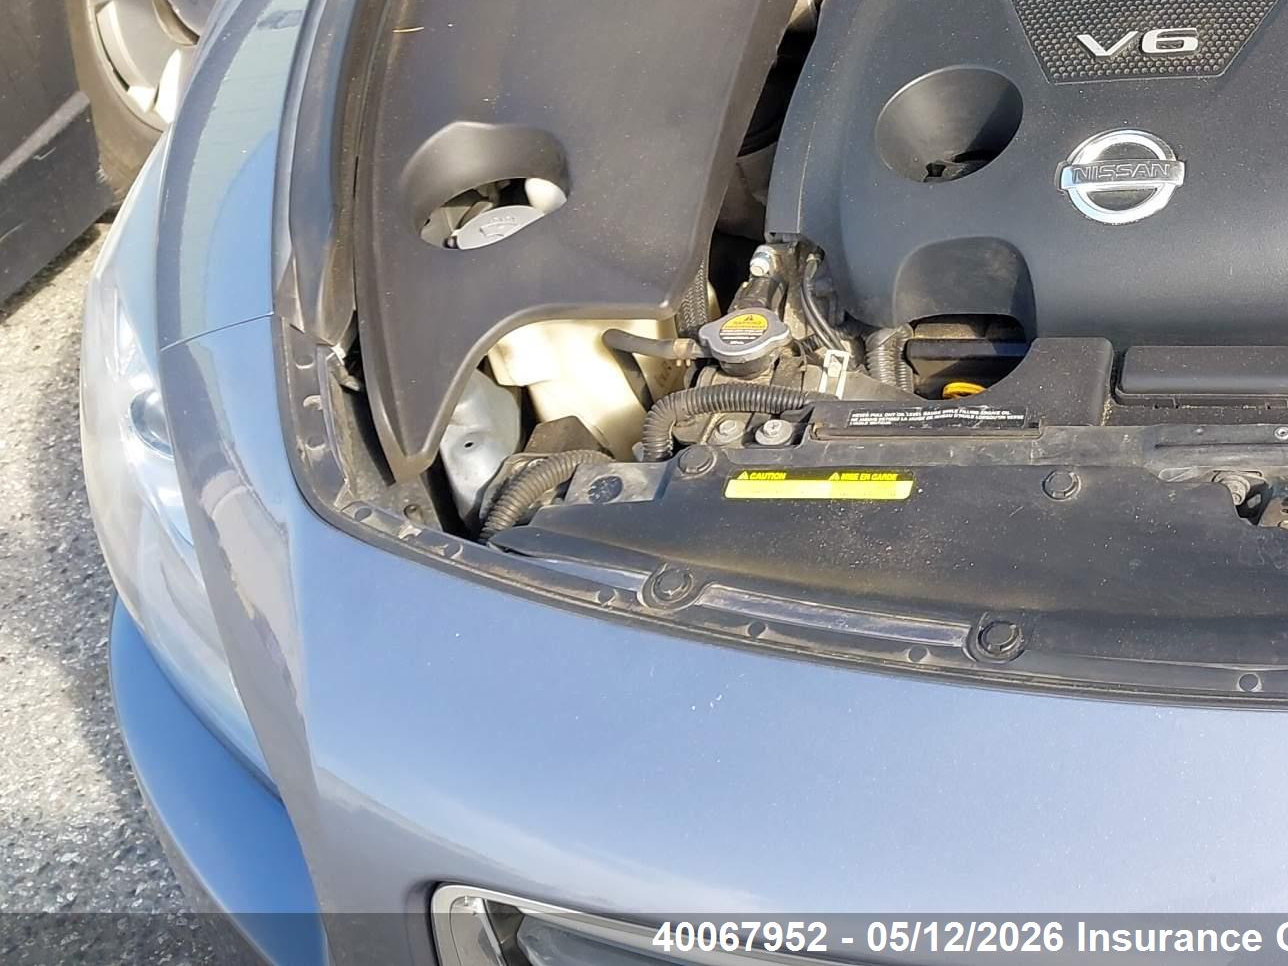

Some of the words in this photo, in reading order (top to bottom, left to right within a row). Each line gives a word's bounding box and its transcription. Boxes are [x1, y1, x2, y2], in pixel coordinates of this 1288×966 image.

[1076, 27, 1200, 58] V6
[1072, 163, 1170, 182] NISSAN
[749, 471, 787, 481] CAUTION
[860, 472, 871, 481] EN
[871, 472, 899, 481] GARDE
